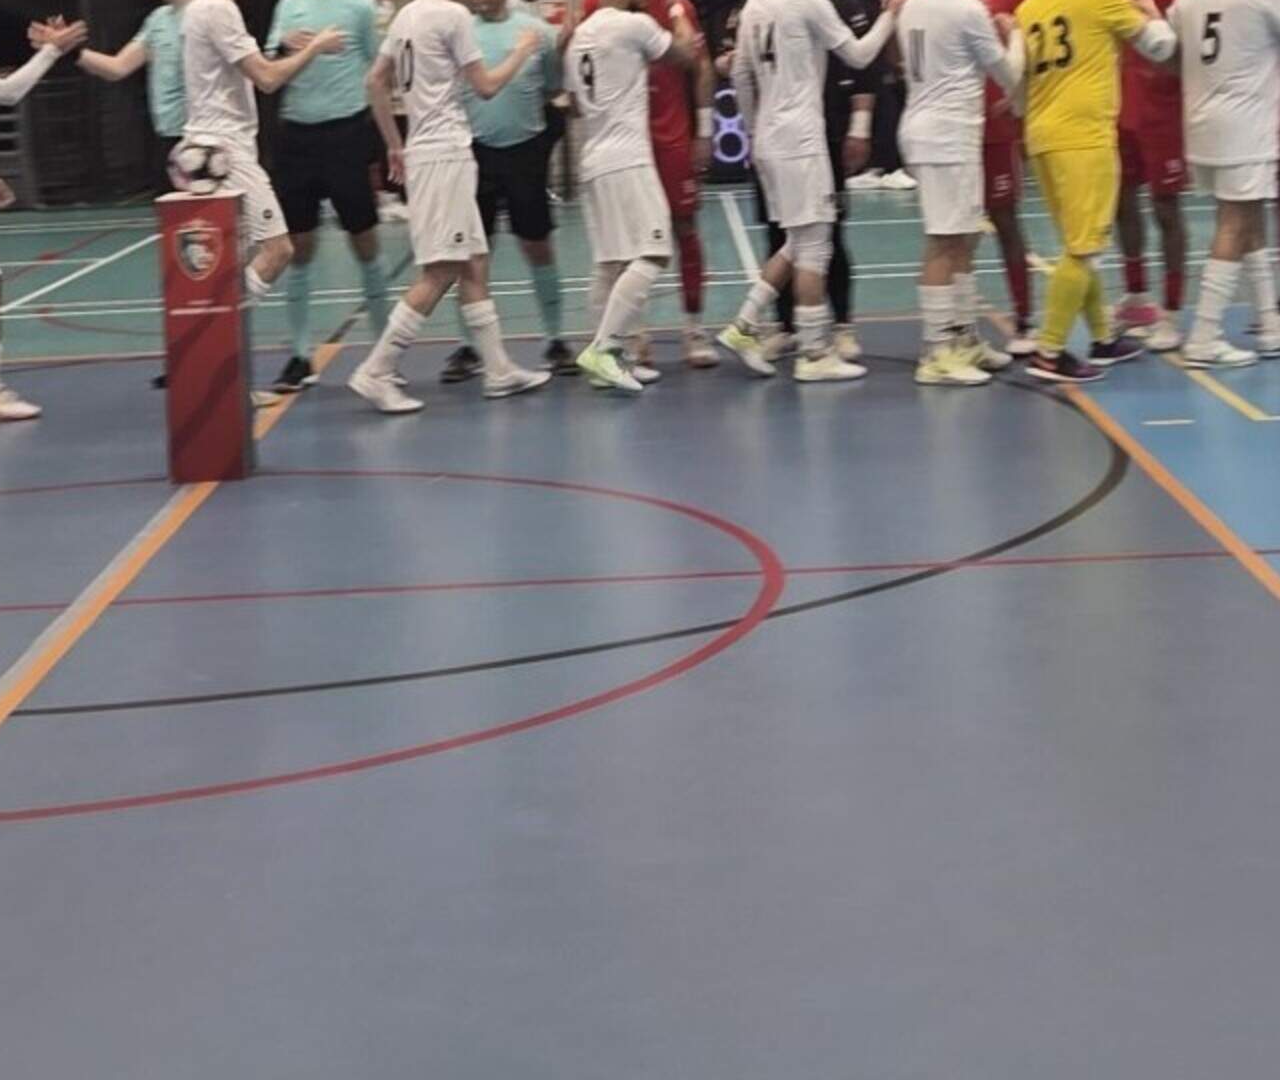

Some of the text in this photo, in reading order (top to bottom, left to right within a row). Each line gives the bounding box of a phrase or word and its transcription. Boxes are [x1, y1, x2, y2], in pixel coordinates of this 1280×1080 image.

[1027, 15, 1074, 74] 23
[1200, 12, 1224, 65] 5
[578, 51, 596, 102] 9
